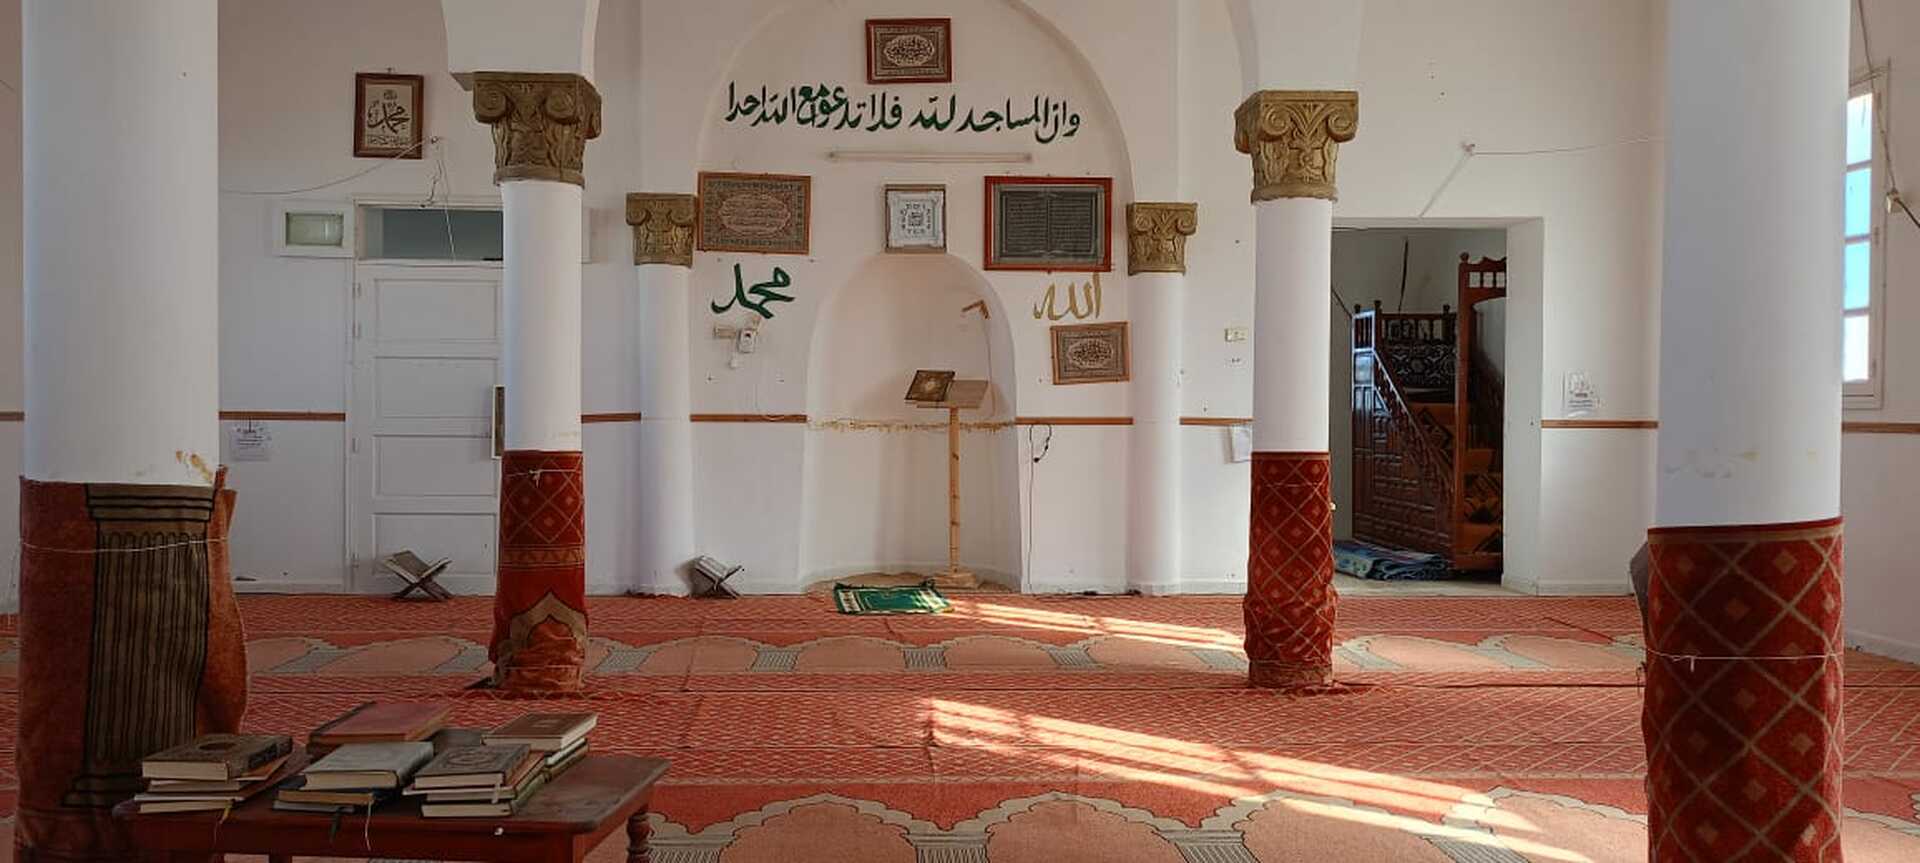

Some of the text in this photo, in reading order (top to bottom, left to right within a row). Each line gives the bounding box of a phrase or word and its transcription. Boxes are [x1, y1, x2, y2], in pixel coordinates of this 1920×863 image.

[866, 91, 903, 132] فلا
[955, 95, 1049, 132] المساجد
[711, 263, 796, 319] محمد
[1033, 267, 1102, 321] الله
